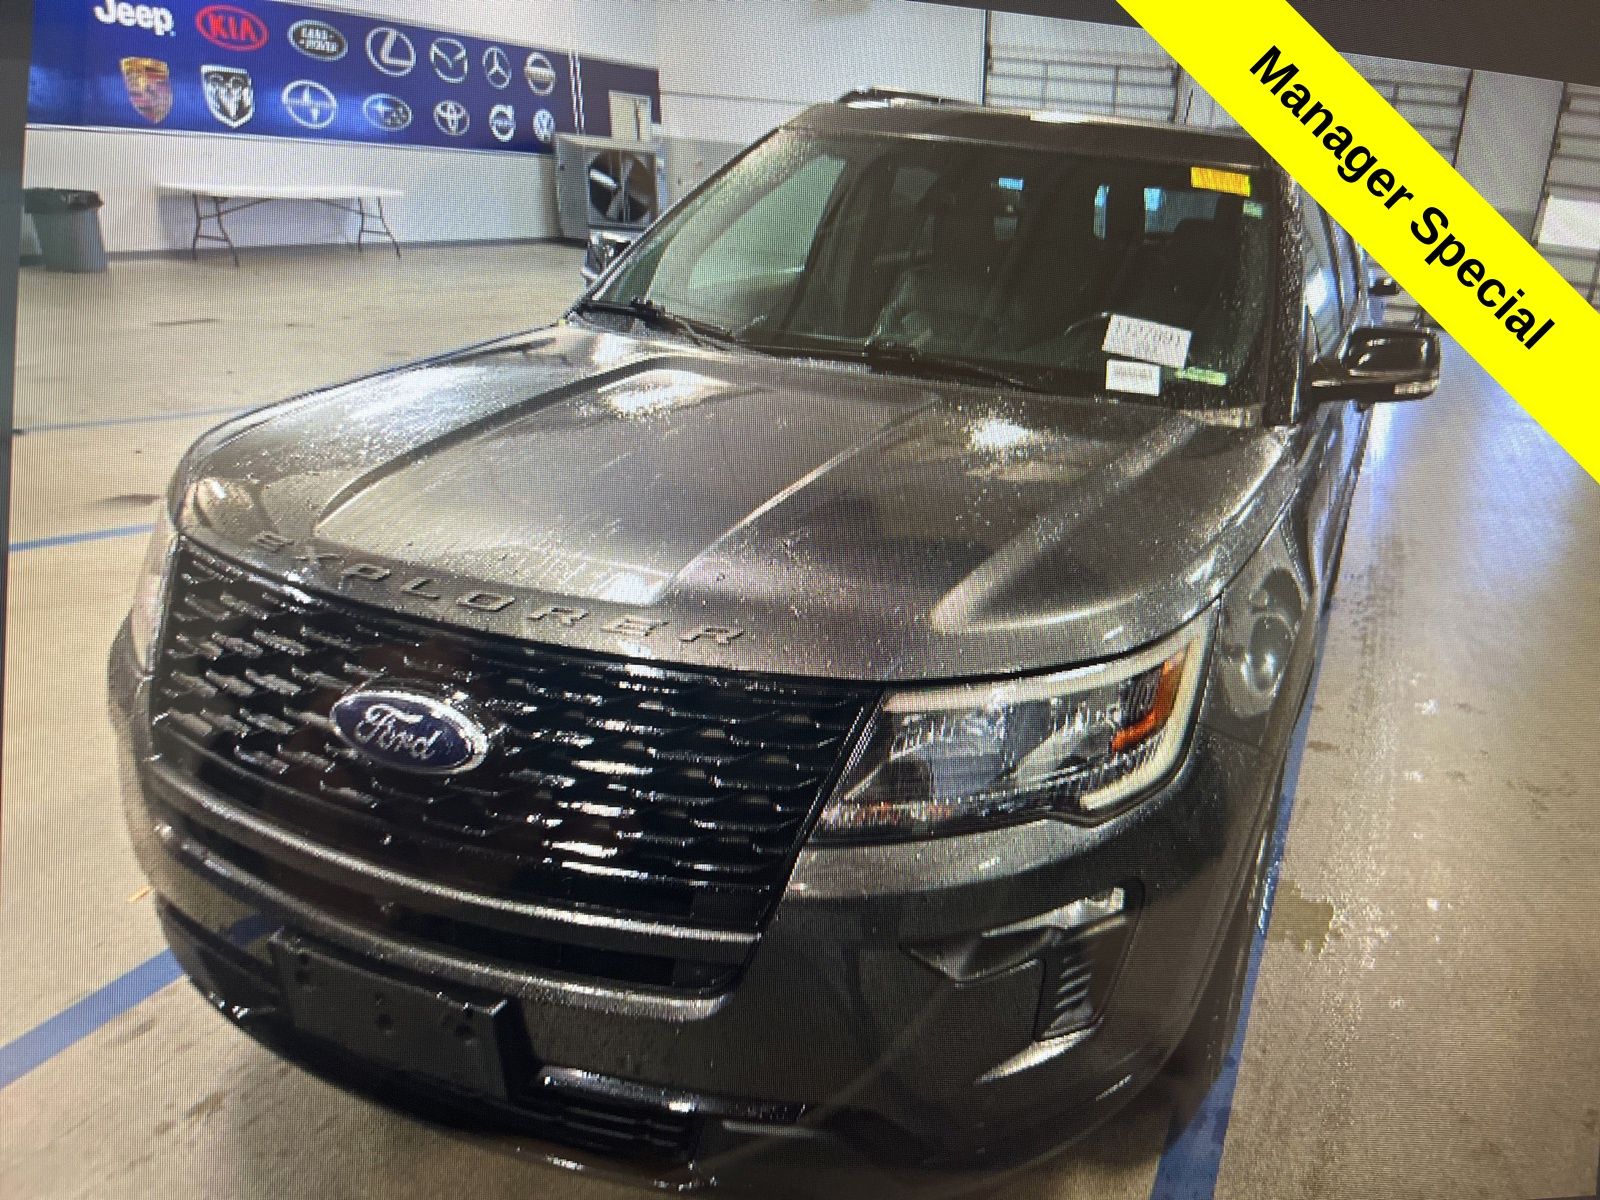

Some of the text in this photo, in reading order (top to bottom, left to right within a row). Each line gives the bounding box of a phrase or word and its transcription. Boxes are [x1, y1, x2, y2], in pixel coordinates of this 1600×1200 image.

[94, 0, 174, 36] Jeep
[208, 13, 257, 42] KIA
[253, 530, 744, 645] EXPLORER
[354, 703, 444, 760] Ford
